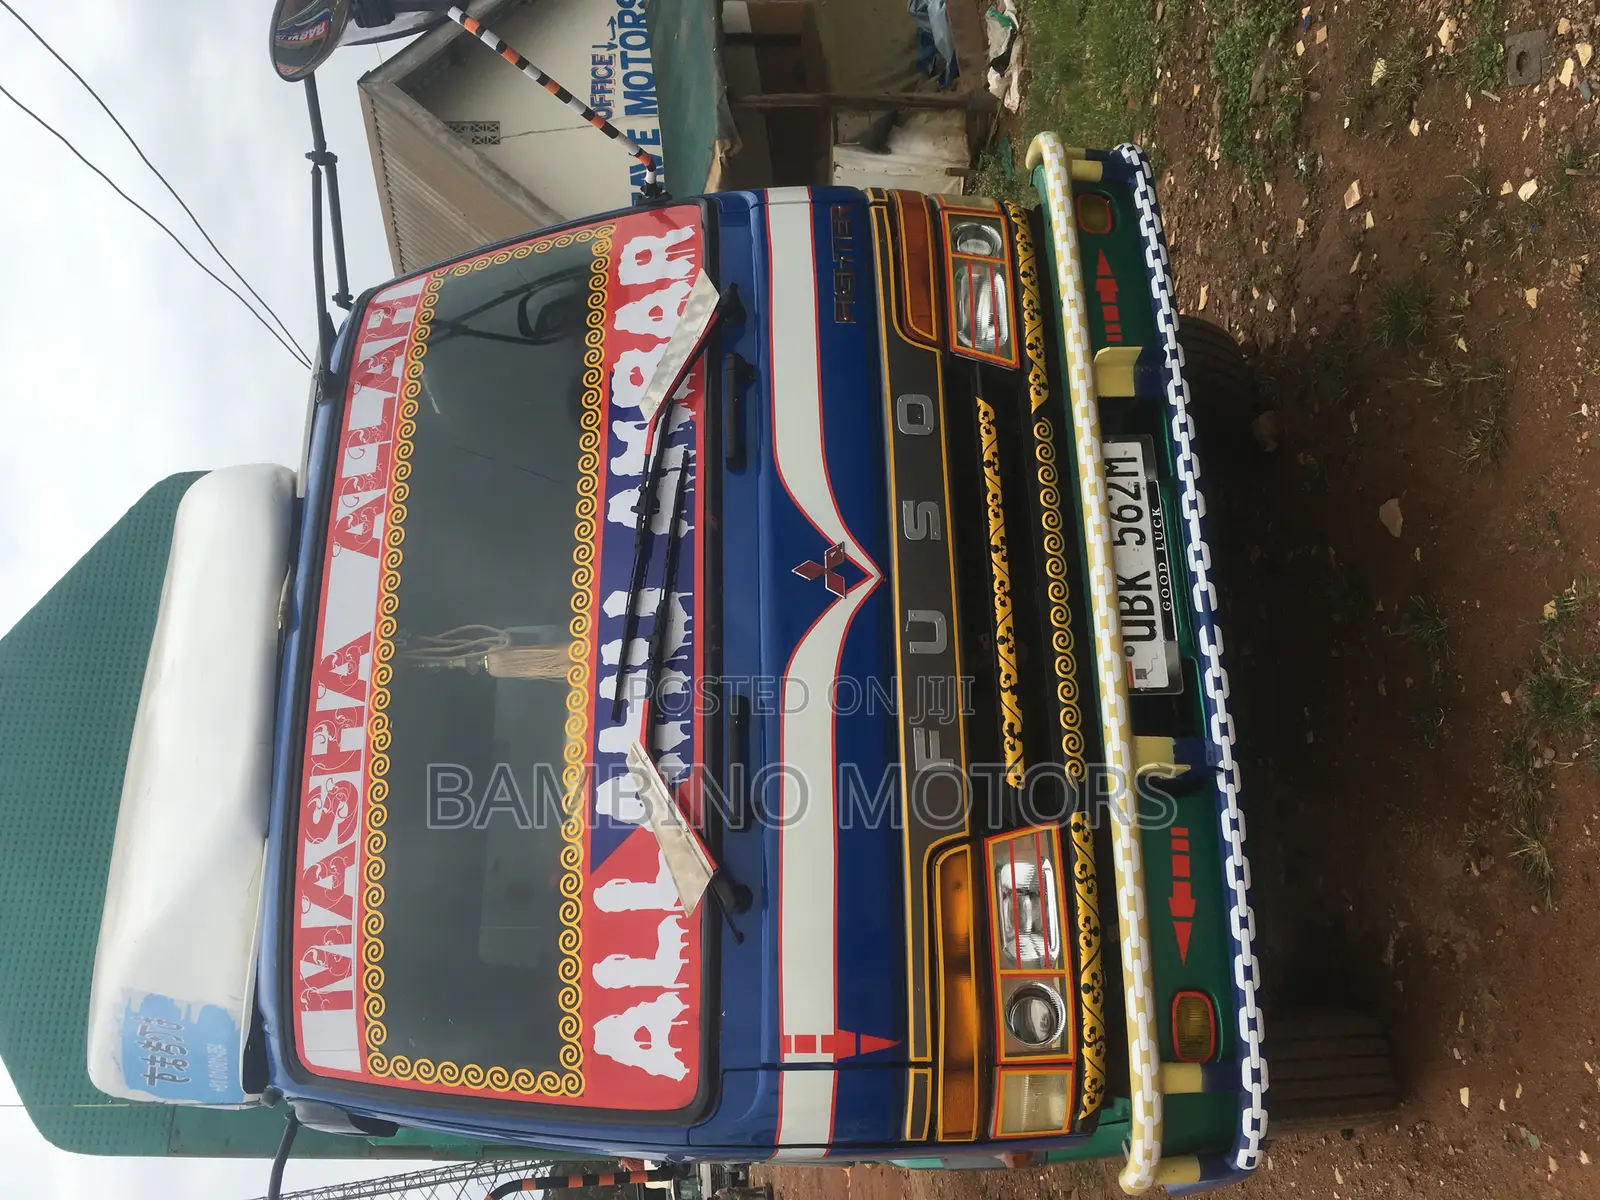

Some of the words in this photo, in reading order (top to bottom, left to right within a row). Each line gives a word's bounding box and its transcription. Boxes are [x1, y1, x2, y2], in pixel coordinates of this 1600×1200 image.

[590, 53, 616, 120] OFFICE
[830, 205, 856, 324] FIGHTER
[332, 292, 421, 559] ALLAH
[1103, 456, 1147, 547] 562M
[1151, 507, 1165, 551] LUCK
[896, 393, 954, 771] FUSO
[1115, 570, 1157, 642] UBK
[1157, 562, 1172, 611] GOOD
